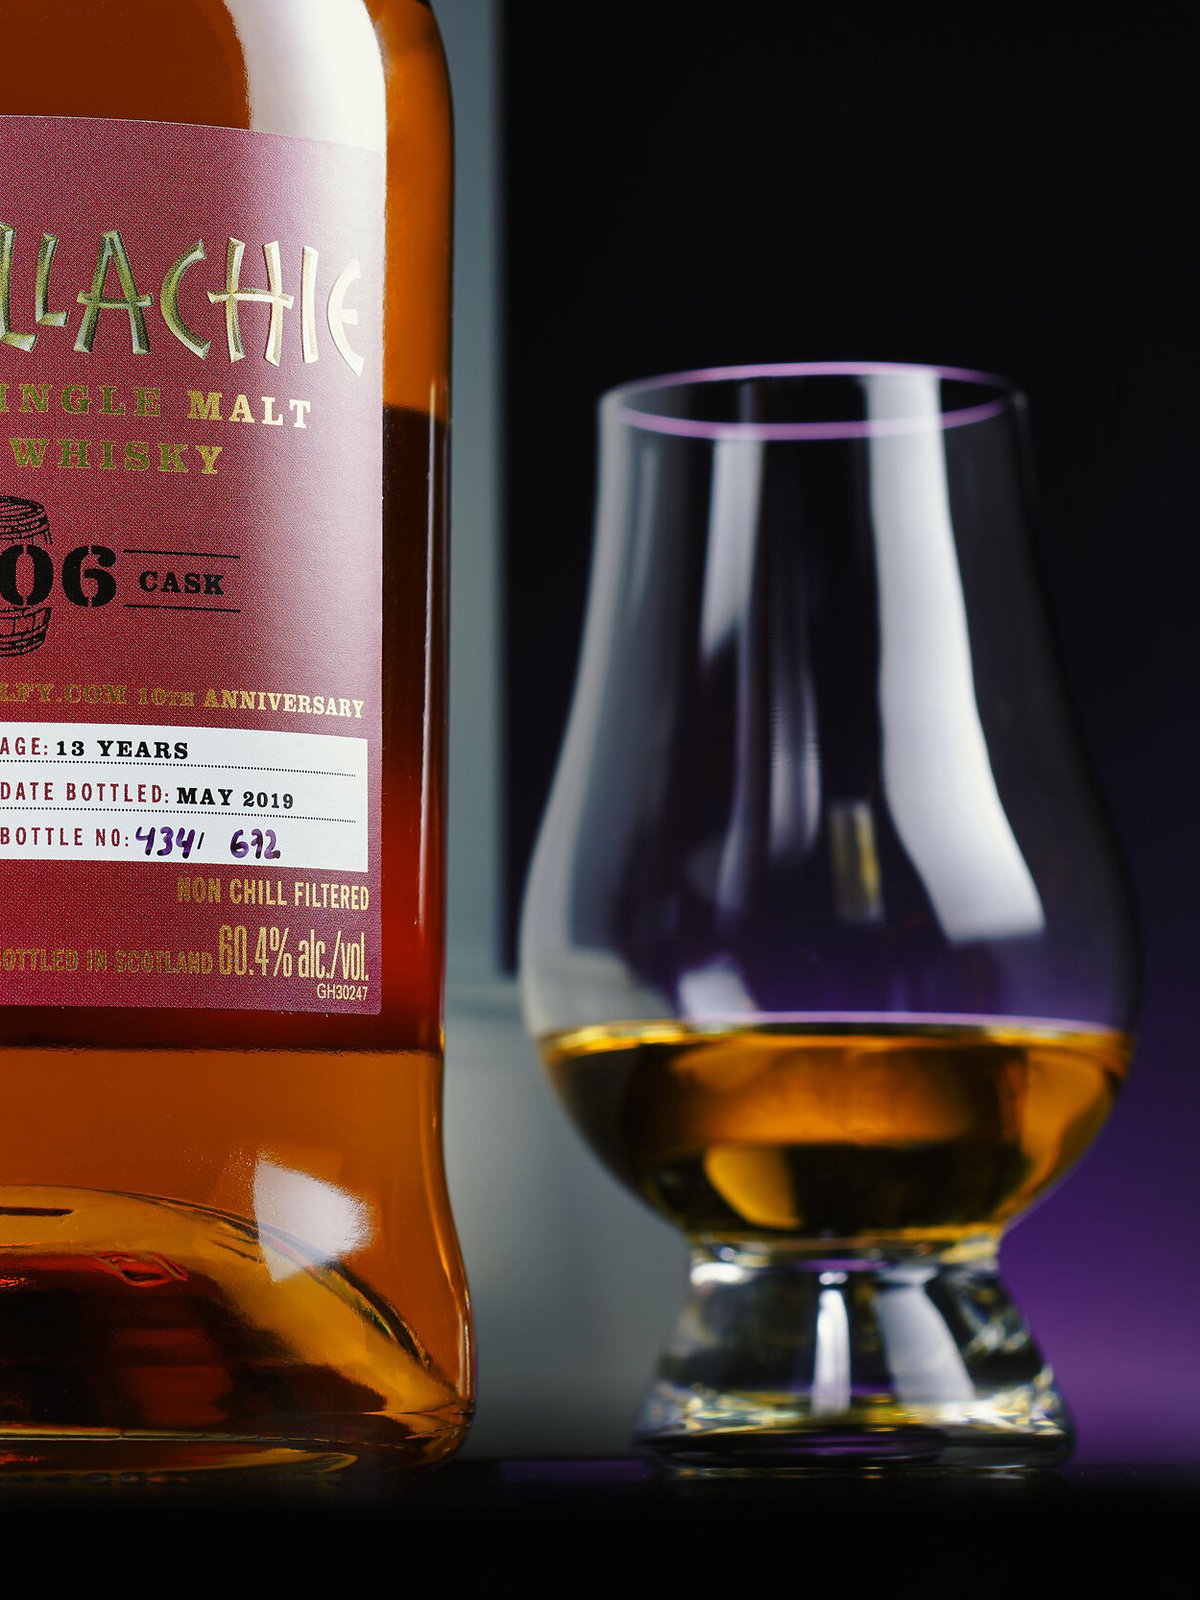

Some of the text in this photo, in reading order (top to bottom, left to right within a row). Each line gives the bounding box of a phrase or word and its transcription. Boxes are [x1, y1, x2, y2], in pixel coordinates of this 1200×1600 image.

[187, 390, 311, 429] MALT
[9, 437, 222, 475] WHISKY
[139, 570, 225, 596] CASK
[138, 688, 195, 707] 10TH
[202, 688, 365, 719] ANNIVERSARY
[0, 737, 189, 760] AGE: 13 YEARS
[0, 781, 294, 810] DATE BOTTLED: MAY 2019
[0, 826, 129, 848] BOTTLE NO:
[177, 877, 369, 911] NON CHILL FILTERED
[86, 949, 107, 973] IN
[115, 950, 214, 975] SCOTLAND
[218, 925, 370, 982] 60.4% alc./vol.
[316, 983, 368, 1001] GH30247
